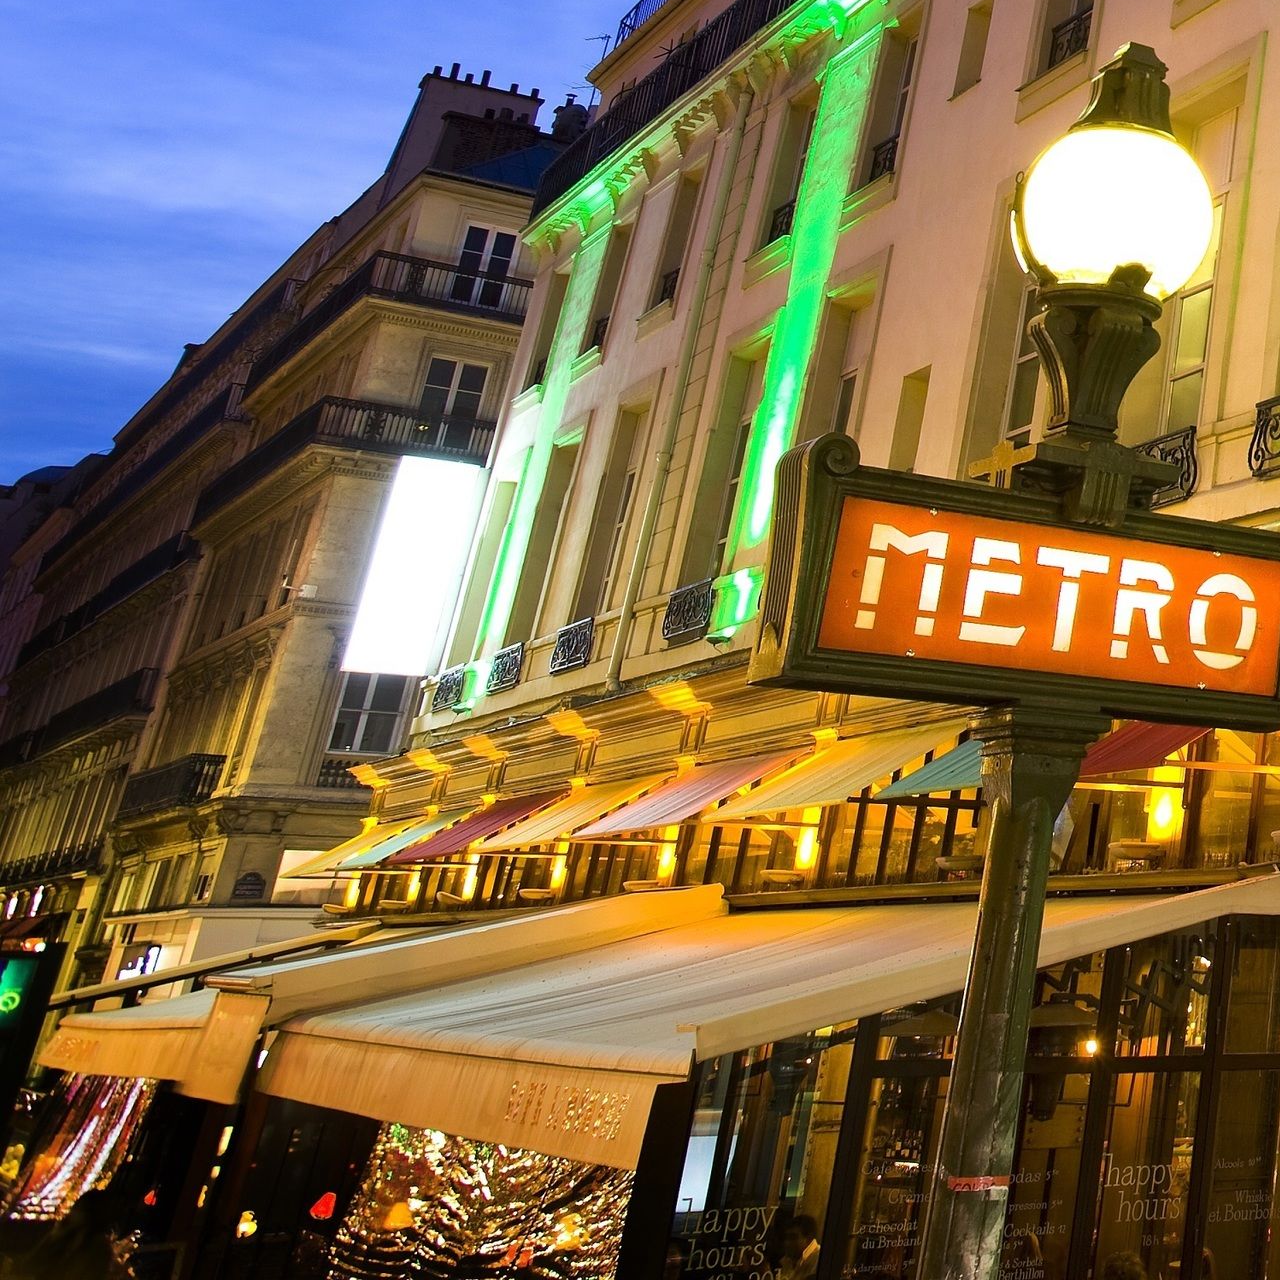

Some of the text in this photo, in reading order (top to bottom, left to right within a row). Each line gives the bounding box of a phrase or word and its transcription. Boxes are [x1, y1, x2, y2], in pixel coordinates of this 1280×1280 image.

[854, 523, 1258, 670] METRO
[1009, 1167, 1042, 1185] odas
[1103, 1153, 1176, 1195] happy
[681, 1198, 779, 1243] happy
[1115, 1191, 1182, 1222] hours
[868, 1218, 918, 1234] chocolat
[1004, 1221, 1055, 1238] Cocktails
[685, 1239, 767, 1272] hours
[862, 1237, 875, 1250] du
